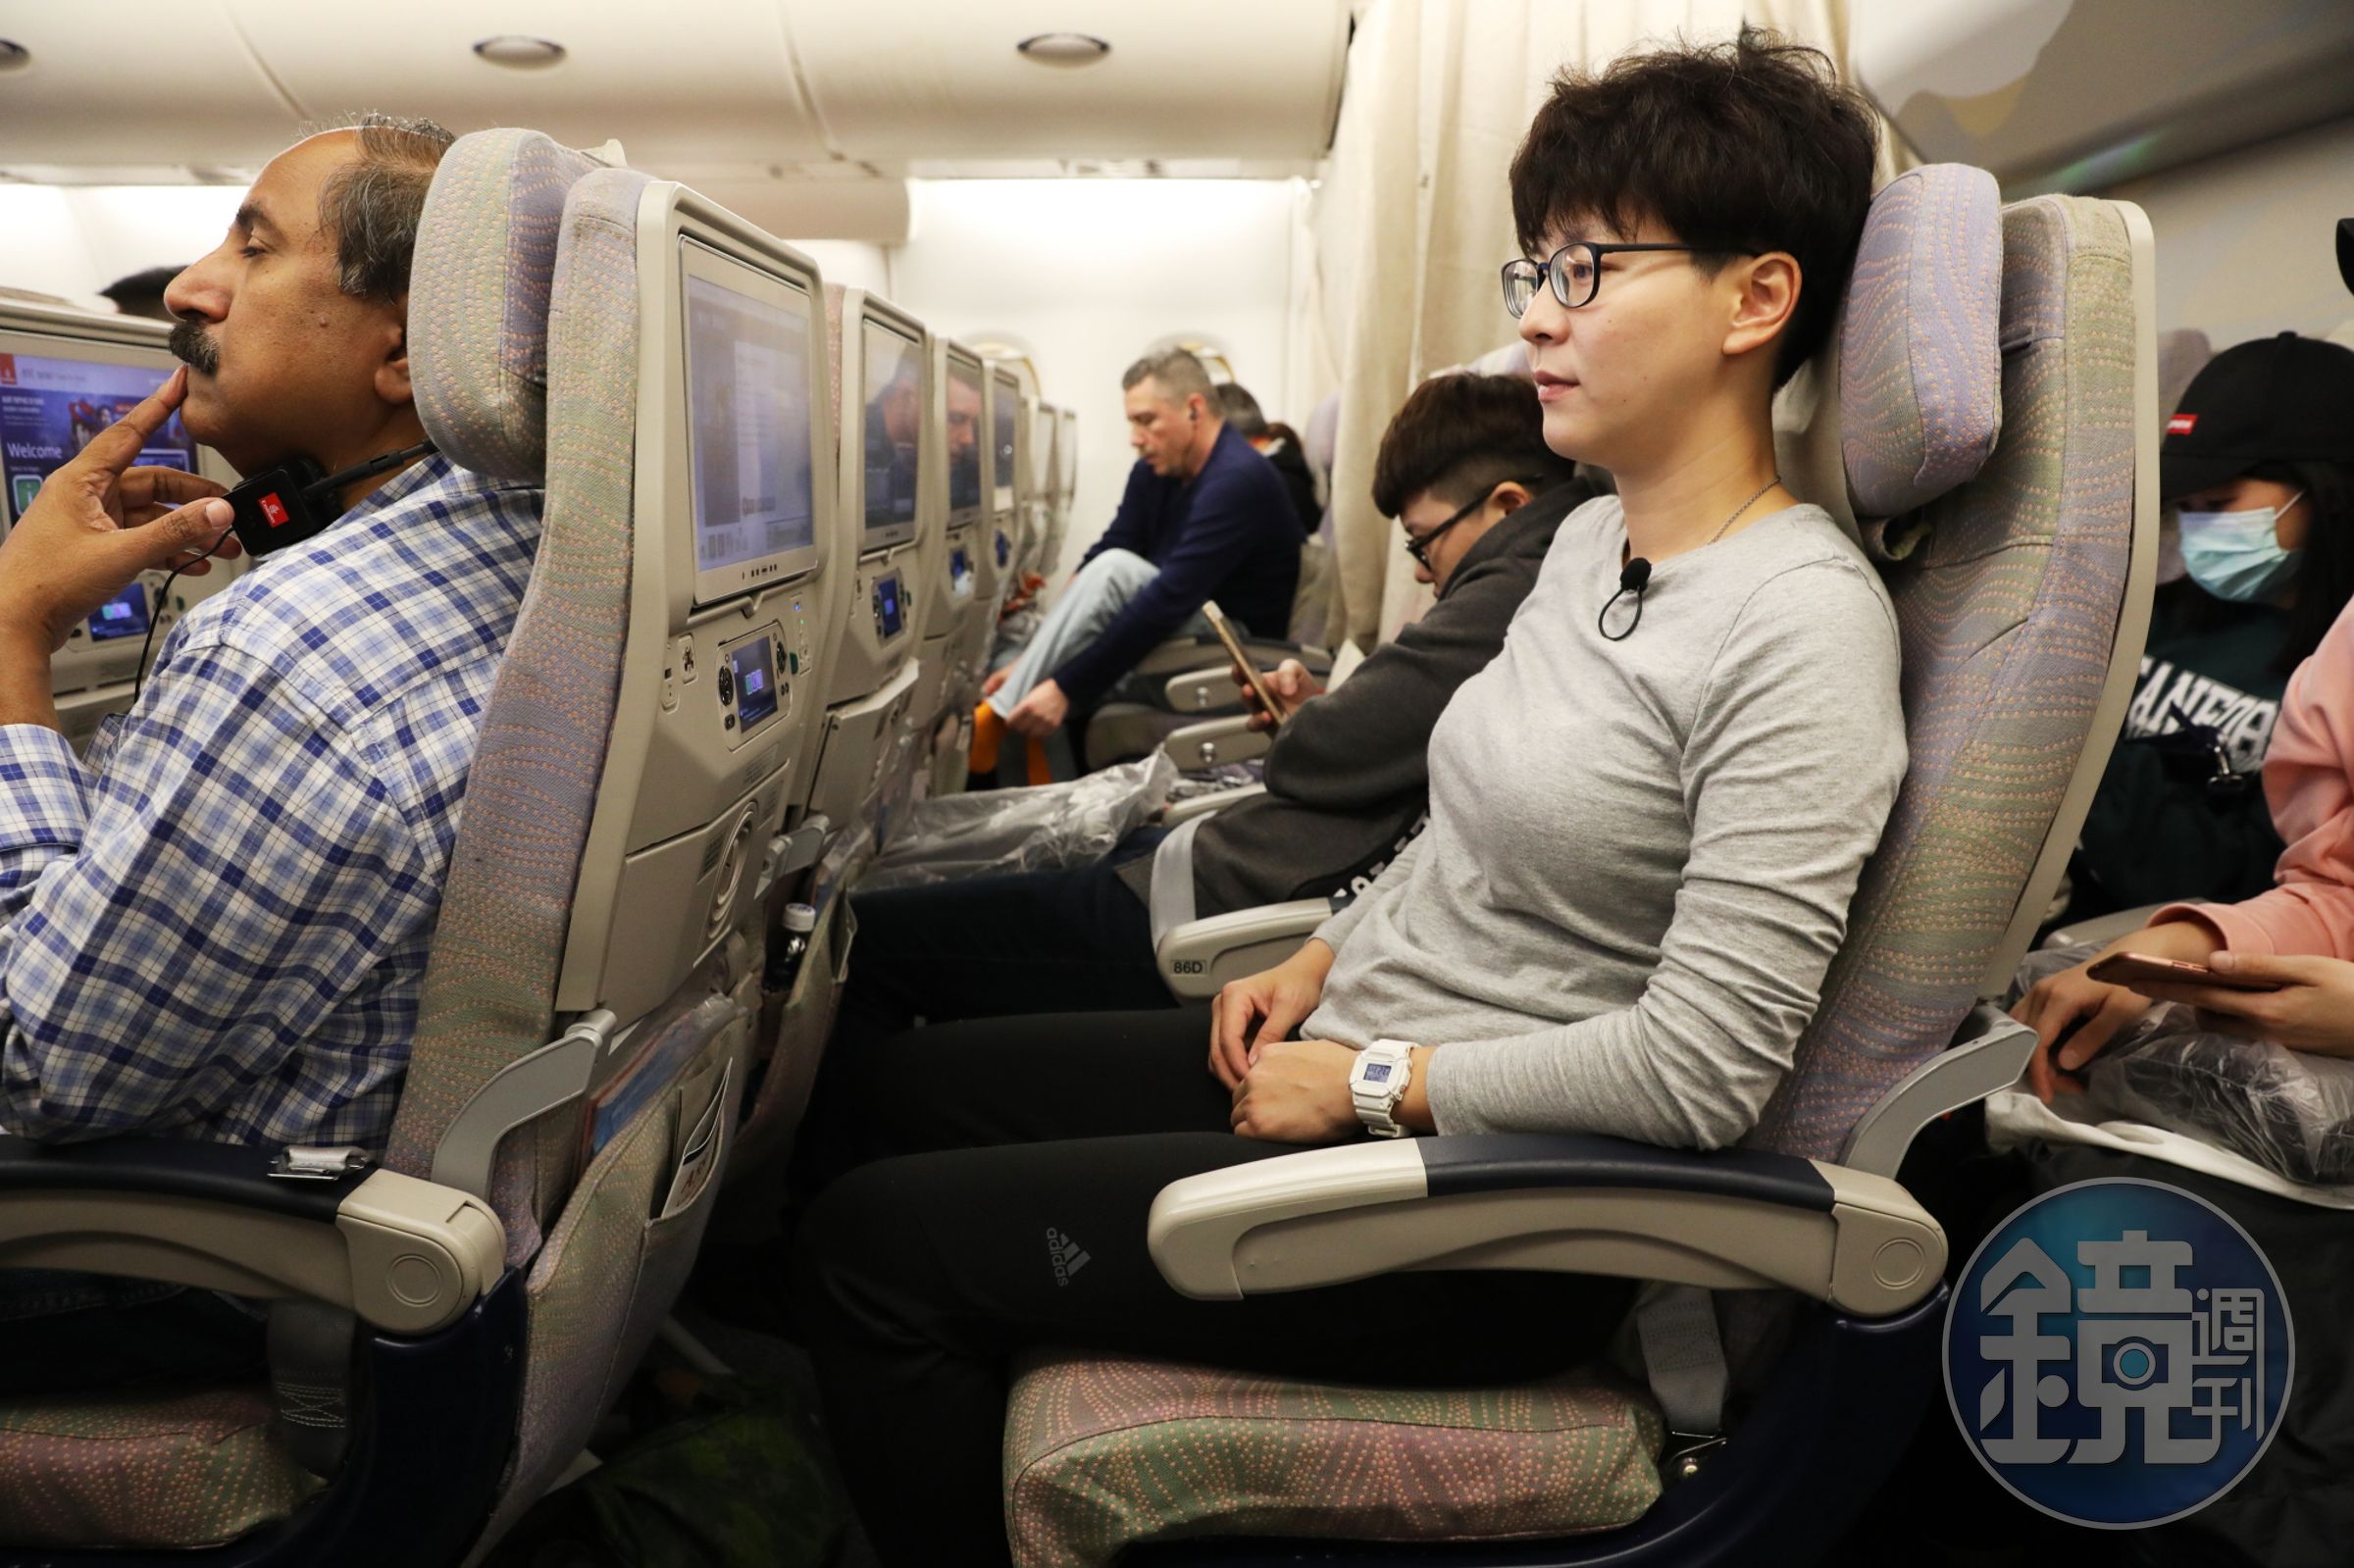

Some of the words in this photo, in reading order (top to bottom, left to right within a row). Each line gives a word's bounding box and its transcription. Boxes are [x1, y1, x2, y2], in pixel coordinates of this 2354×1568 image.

[7, 441, 63, 459] Welcome
[1173, 961, 1203, 974] 86D
[1046, 1227, 1069, 1287] adidas
